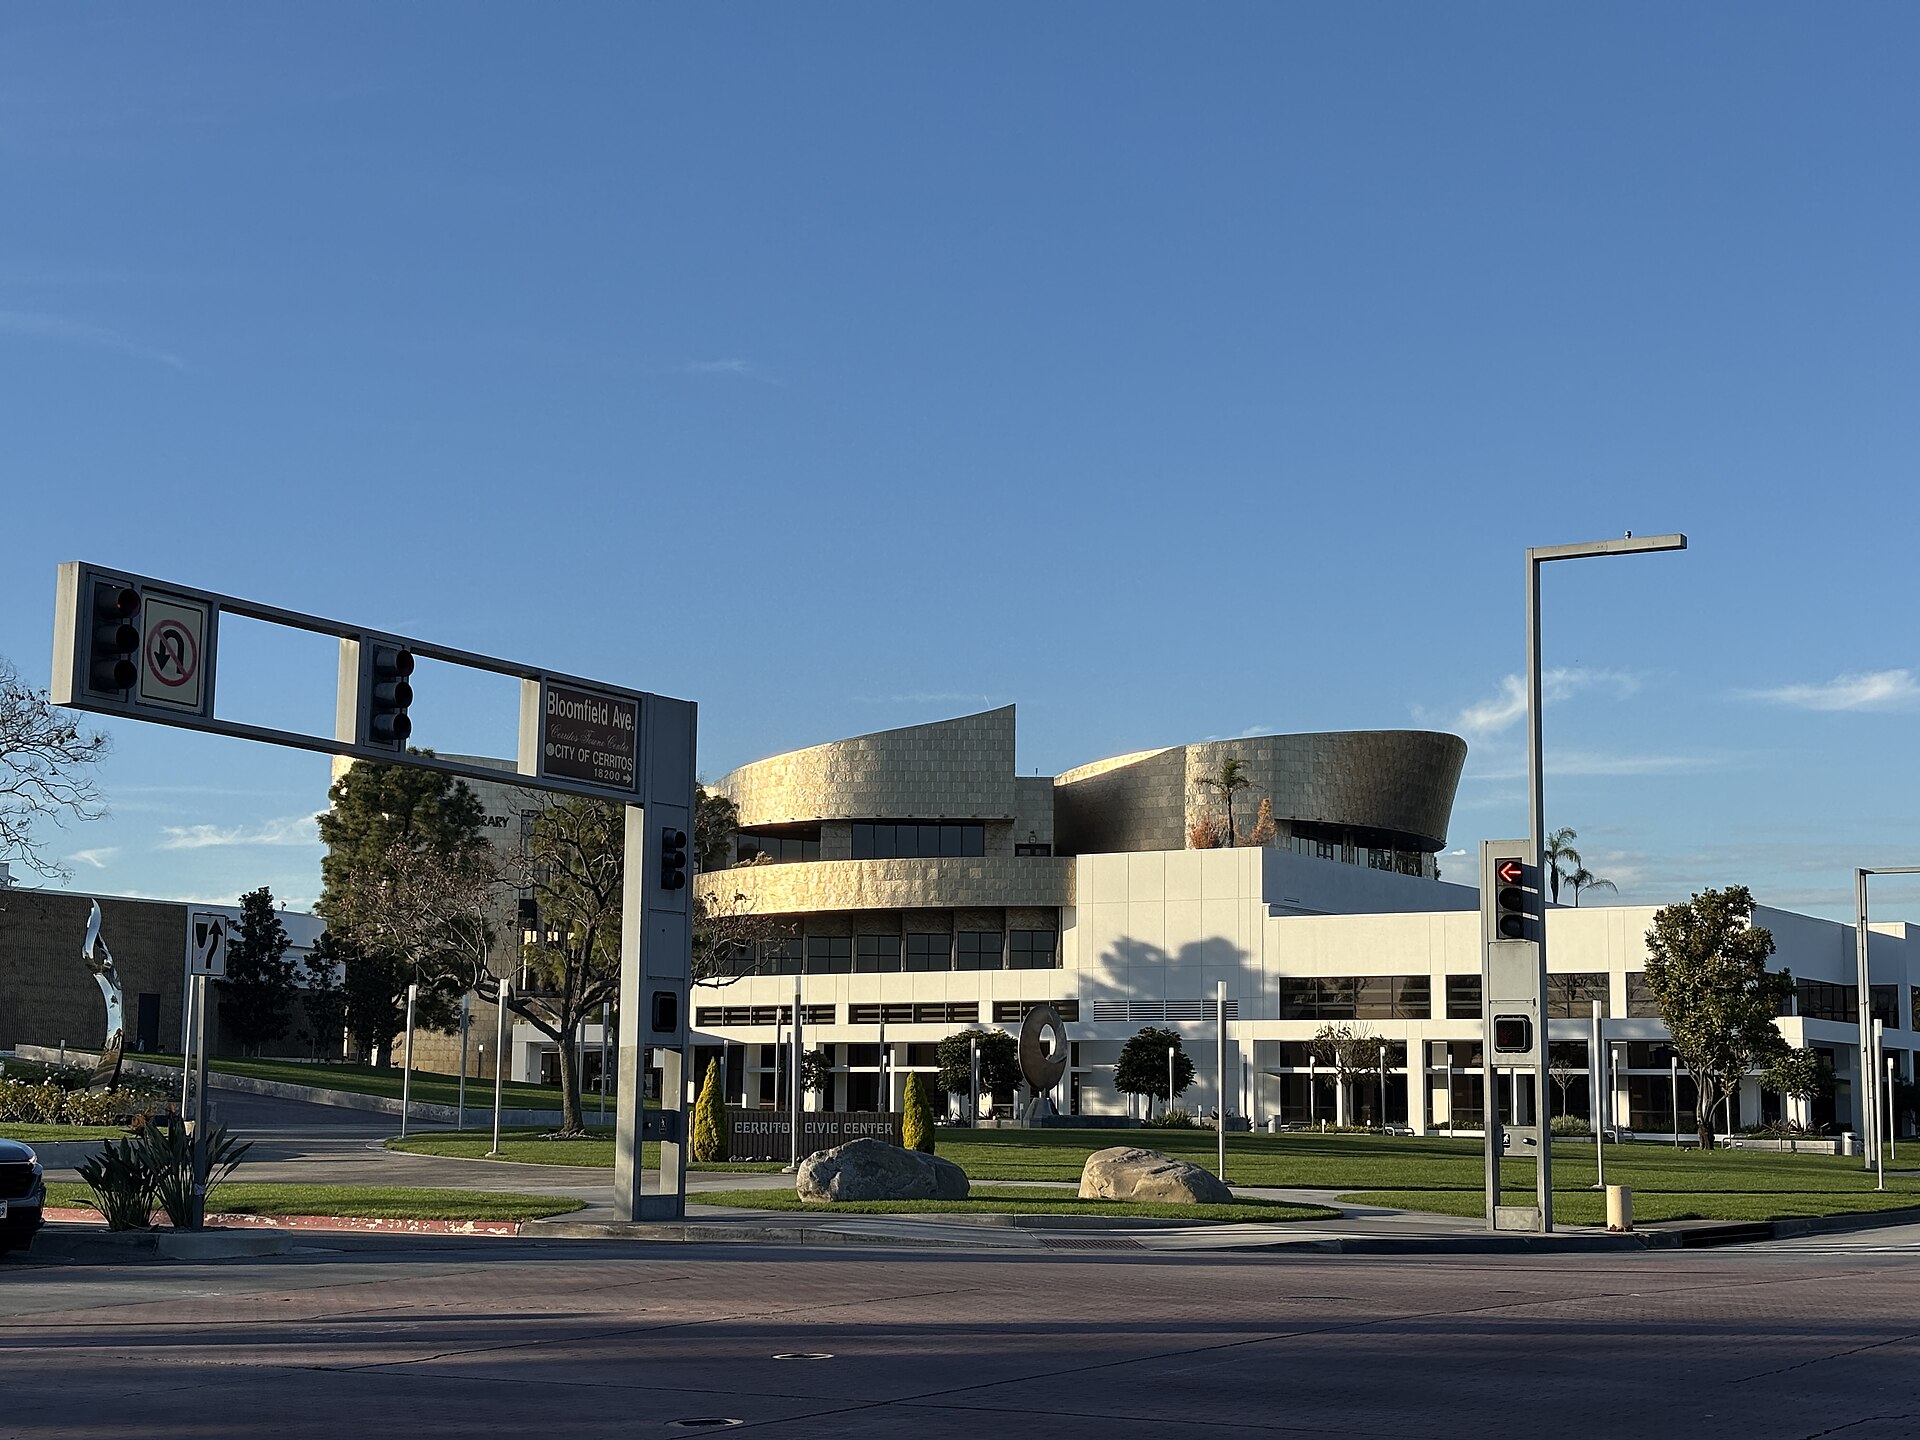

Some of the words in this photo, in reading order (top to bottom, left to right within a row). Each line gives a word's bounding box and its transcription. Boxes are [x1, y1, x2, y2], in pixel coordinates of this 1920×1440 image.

[547, 691, 608, 726] Bloomfield
[612, 705, 634, 731] Ave.
[550, 723, 578, 742] Cerritos
[554, 743, 575, 761] CITY
[577, 748, 590, 763] OF
[592, 751, 633, 772] CERRITOS
[594, 768, 620, 781] 18200
[734, 1121, 794, 1135] CERRITO
[804, 1122, 839, 1134] CIVIC
[843, 1122, 893, 1135] CENTER
